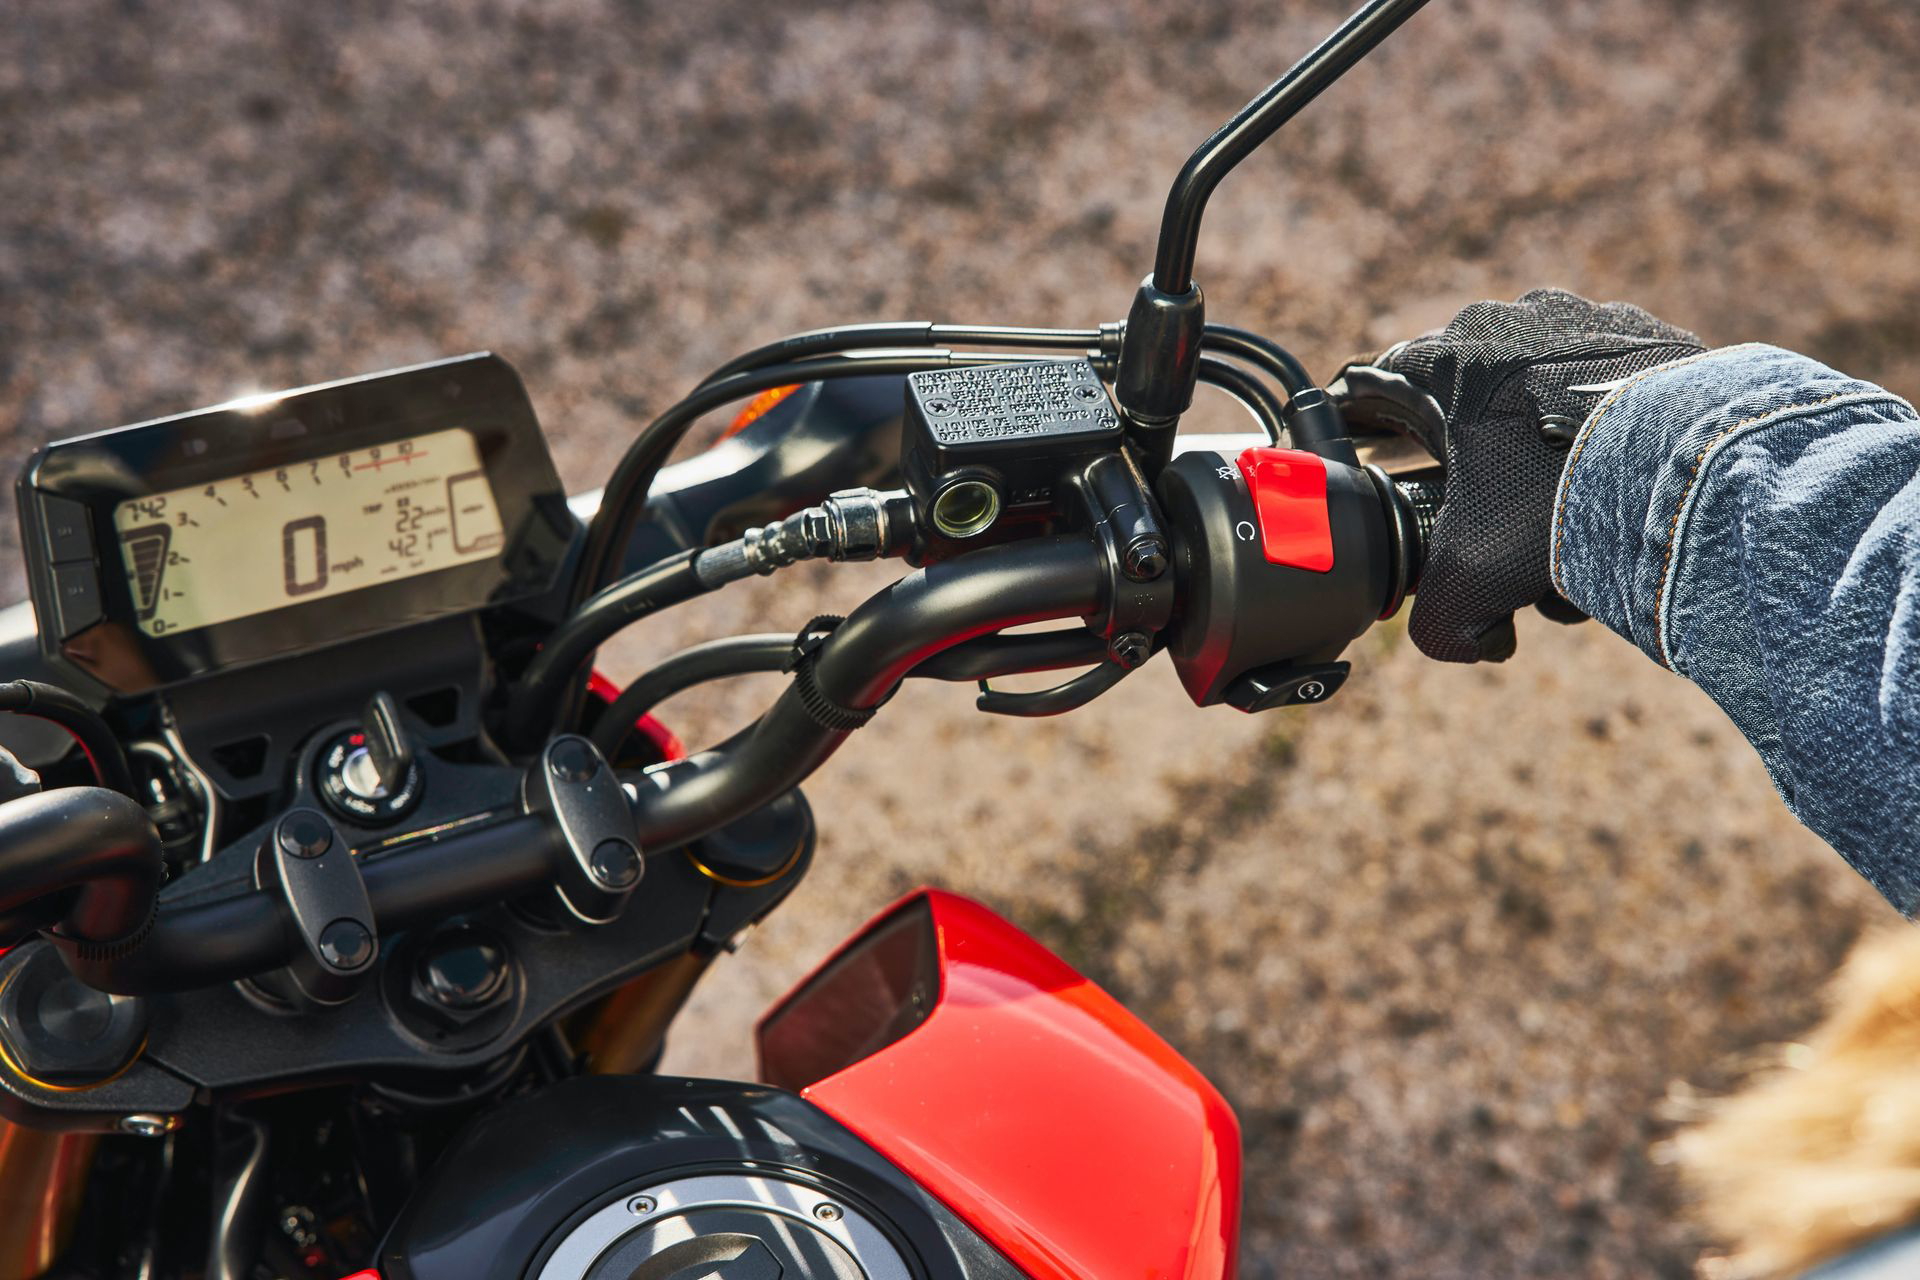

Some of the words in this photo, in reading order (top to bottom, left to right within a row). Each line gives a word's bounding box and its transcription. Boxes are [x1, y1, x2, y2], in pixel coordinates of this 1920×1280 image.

[954, 379, 994, 391] BRAKE
[998, 375, 1036, 388] FLUID
[951, 387, 998, 400] SEALED
[959, 405, 1006, 418] BEFORE
[993, 417, 1012, 427] DE
[204, 485, 216, 499] 4
[242, 476, 254, 491] 5
[276, 468, 288, 483] 6
[308, 460, 319, 475] 7
[339, 454, 350, 469] 8
[369, 447, 381, 461] 9
[177, 511, 188, 527] 3
[168, 551, 179, 566] 2
[283, 514, 328, 597] 0
[153, 619, 166, 635] 0
